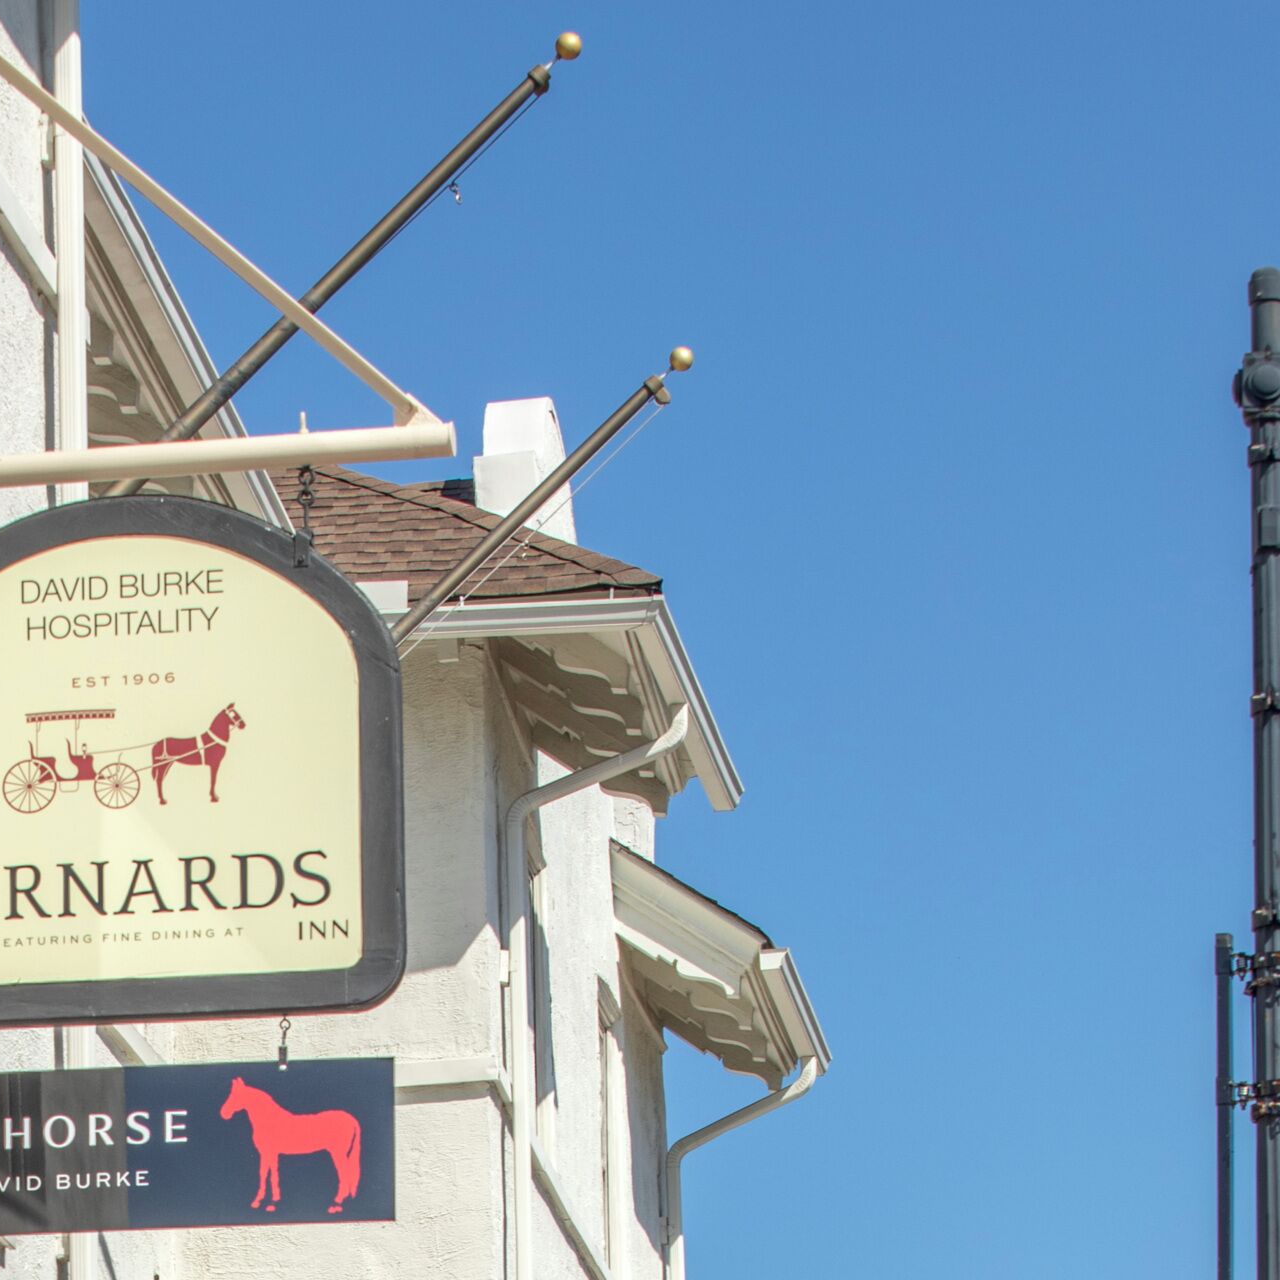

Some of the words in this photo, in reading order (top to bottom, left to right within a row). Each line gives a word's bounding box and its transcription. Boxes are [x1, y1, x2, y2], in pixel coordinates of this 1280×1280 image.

[21, 576, 109, 604] DAVID
[119, 569, 224, 599] BURKE
[26, 606, 219, 641] HOSPITALITY
[71, 676, 110, 689] EST
[122, 671, 176, 686] 1906
[102, 931, 143, 944] FINE
[151, 928, 216, 942] DINING
[224, 926, 245, 938] AT
[297, 918, 350, 941] INN
[3, 1110, 188, 1150] HORSE
[56, 1170, 150, 1190] BURKE
